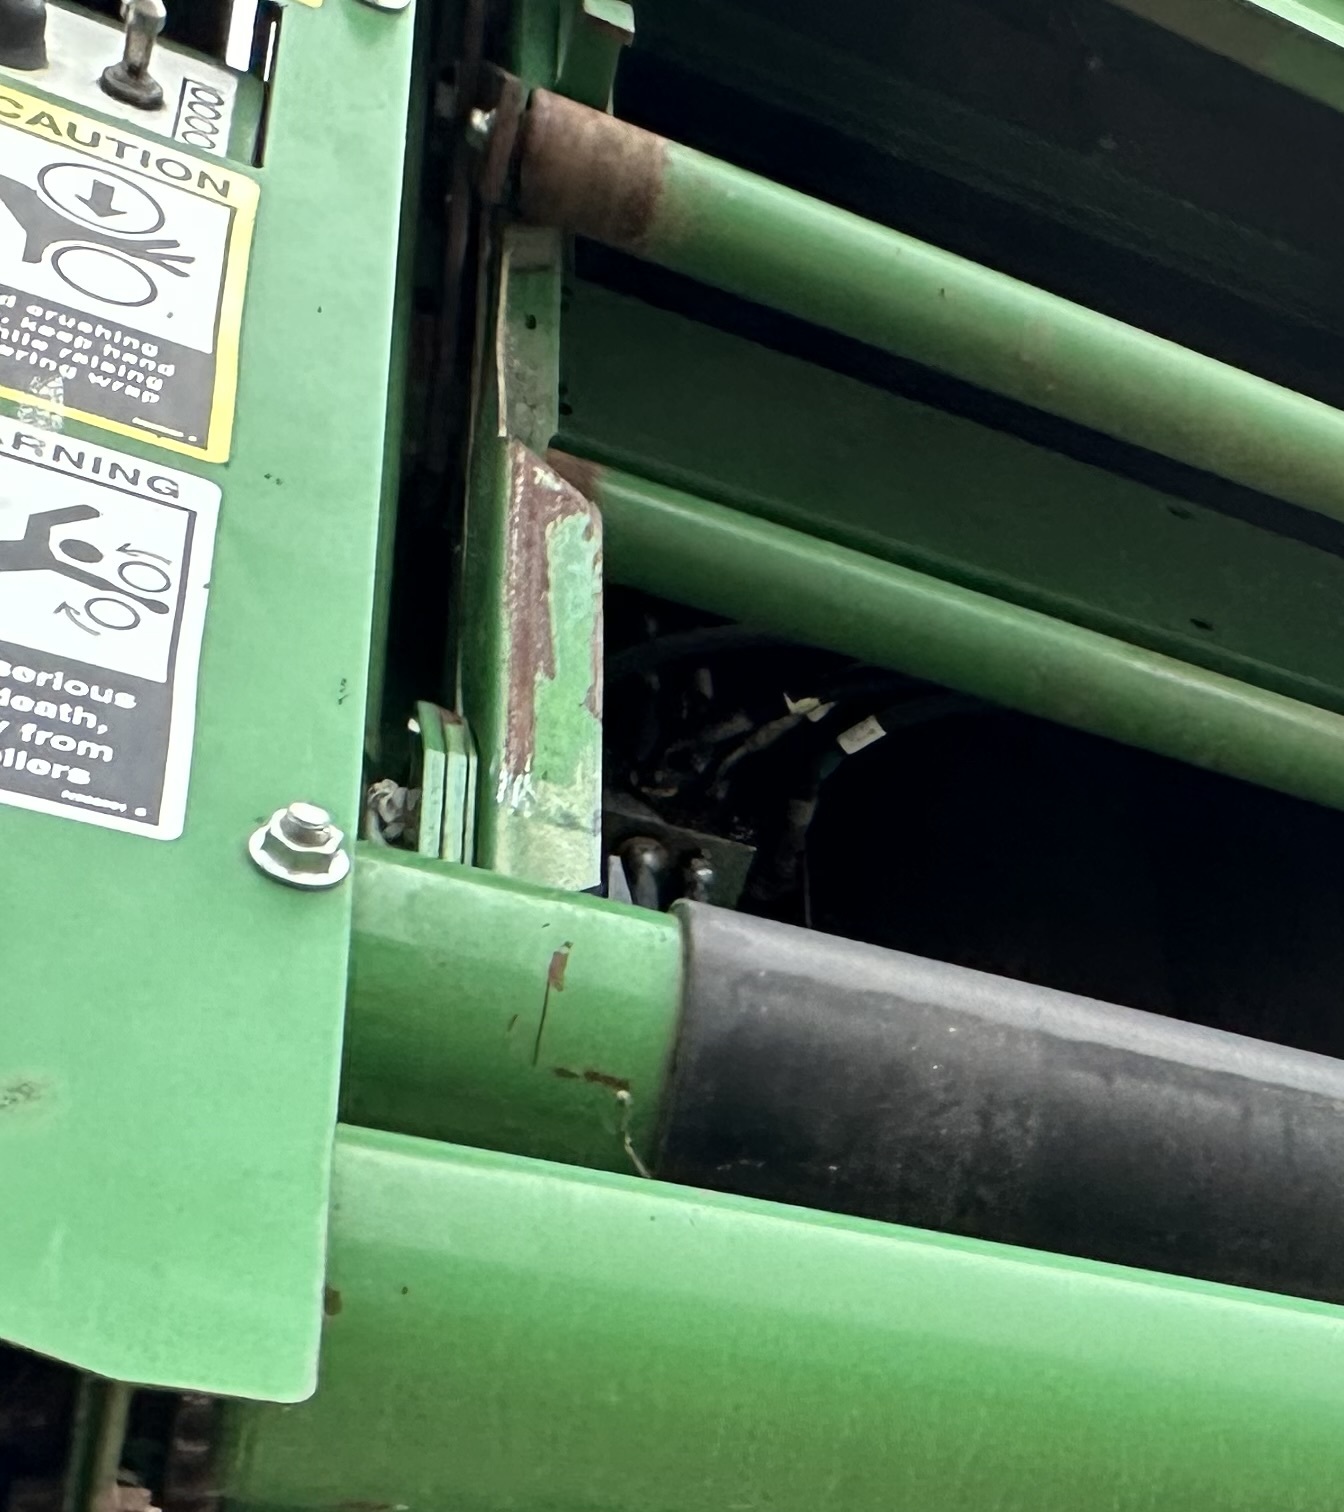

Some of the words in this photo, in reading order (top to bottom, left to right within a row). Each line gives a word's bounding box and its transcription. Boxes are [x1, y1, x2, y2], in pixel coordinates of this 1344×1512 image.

[0, 97, 232, 199] CAUTION
[0, 431, 181, 499] RNING
[20, 722, 114, 763] from
